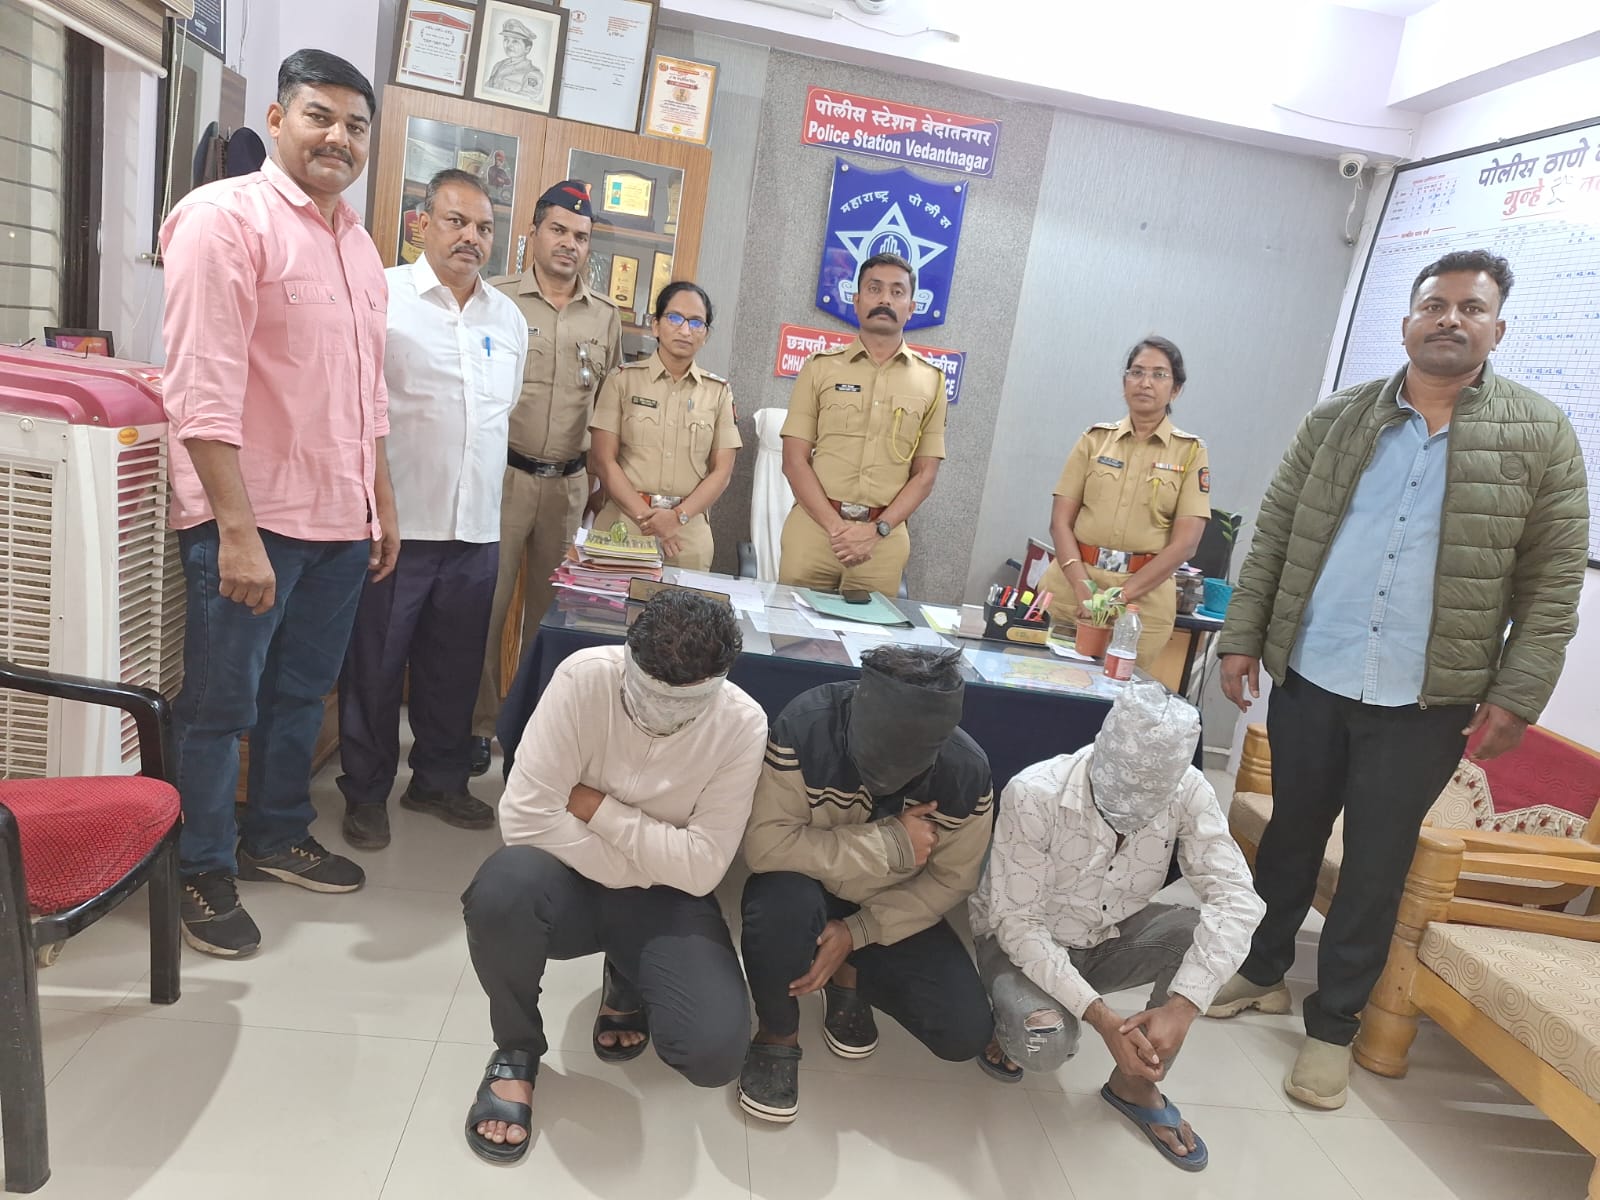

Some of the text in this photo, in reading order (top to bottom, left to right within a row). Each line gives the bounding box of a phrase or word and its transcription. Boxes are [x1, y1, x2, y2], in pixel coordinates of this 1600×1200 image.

[815, 95, 992, 146] पोलीस स्टेशन वेदांतनगर
[808, 121, 989, 171] Police Station Vedantnagar
[1479, 152, 1539, 187] पोलीस
[1543, 137, 1590, 174] ठाणे
[840, 190, 890, 214] महाराष्ट्र
